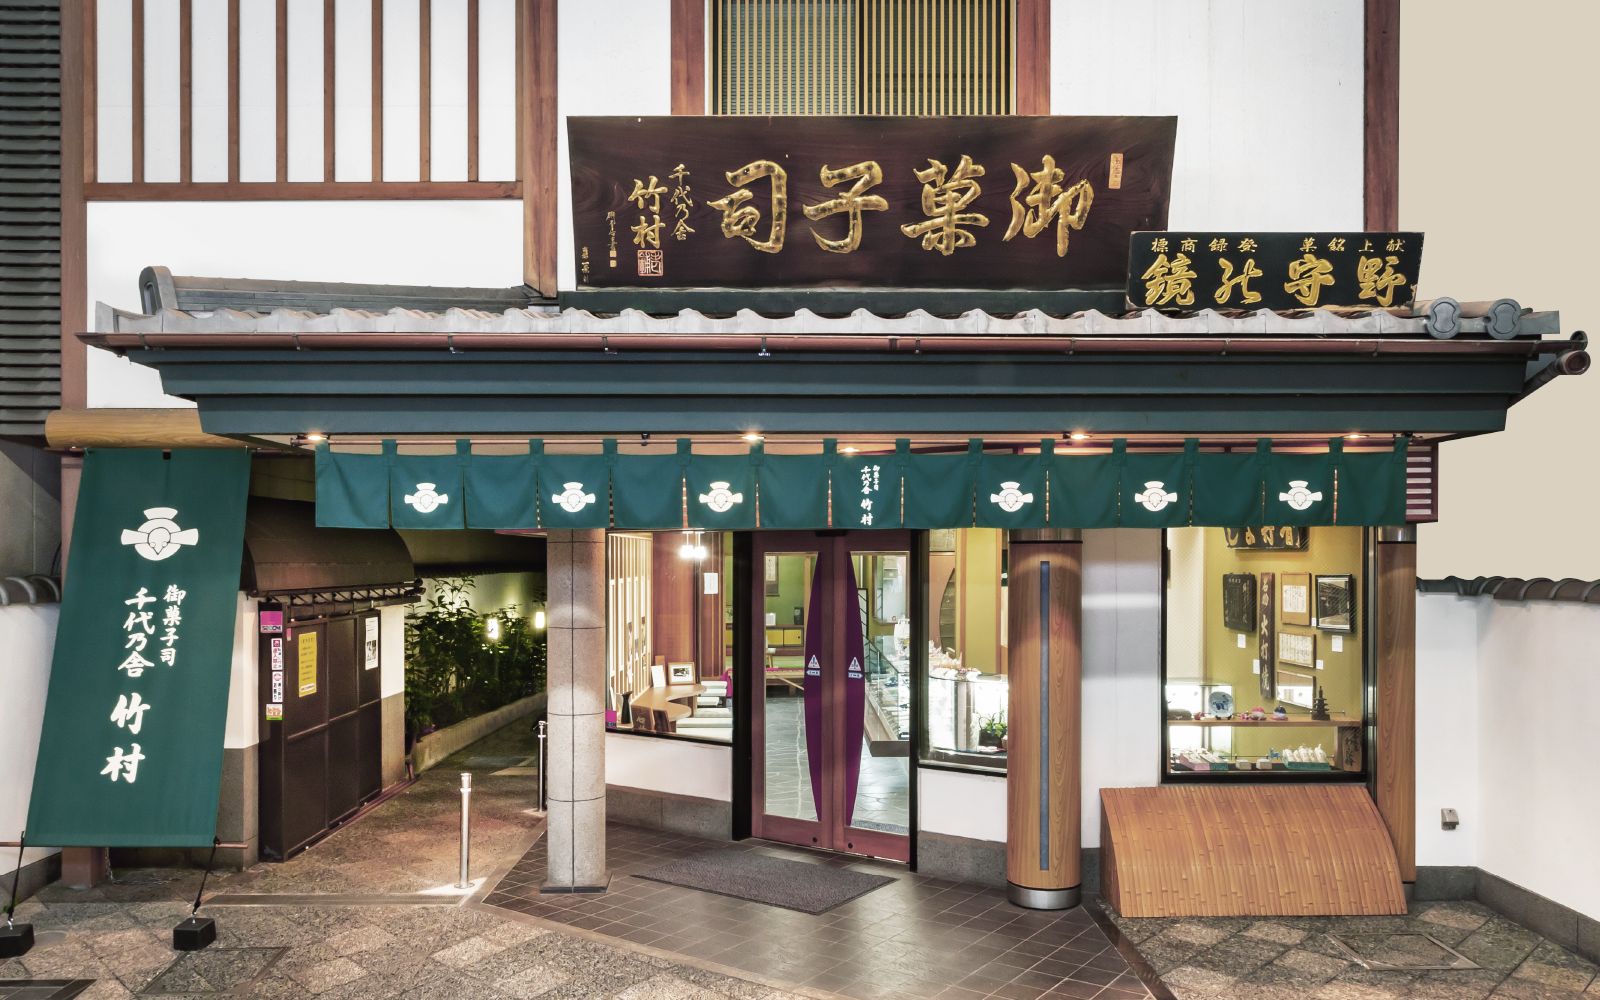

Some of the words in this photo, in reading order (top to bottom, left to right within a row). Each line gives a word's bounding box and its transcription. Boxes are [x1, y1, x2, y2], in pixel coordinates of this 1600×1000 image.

[627, 175, 669, 249] 竹村
[706, 154, 1095, 258] 御菓子司
[1151, 237, 1258, 253] 登録商標
[1299, 237, 1406, 252] 献上銘菓
[860, 498, 874, 526] 竹村
[160, 583, 187, 667] 御菓子司
[100, 692, 151, 784] 竹村
